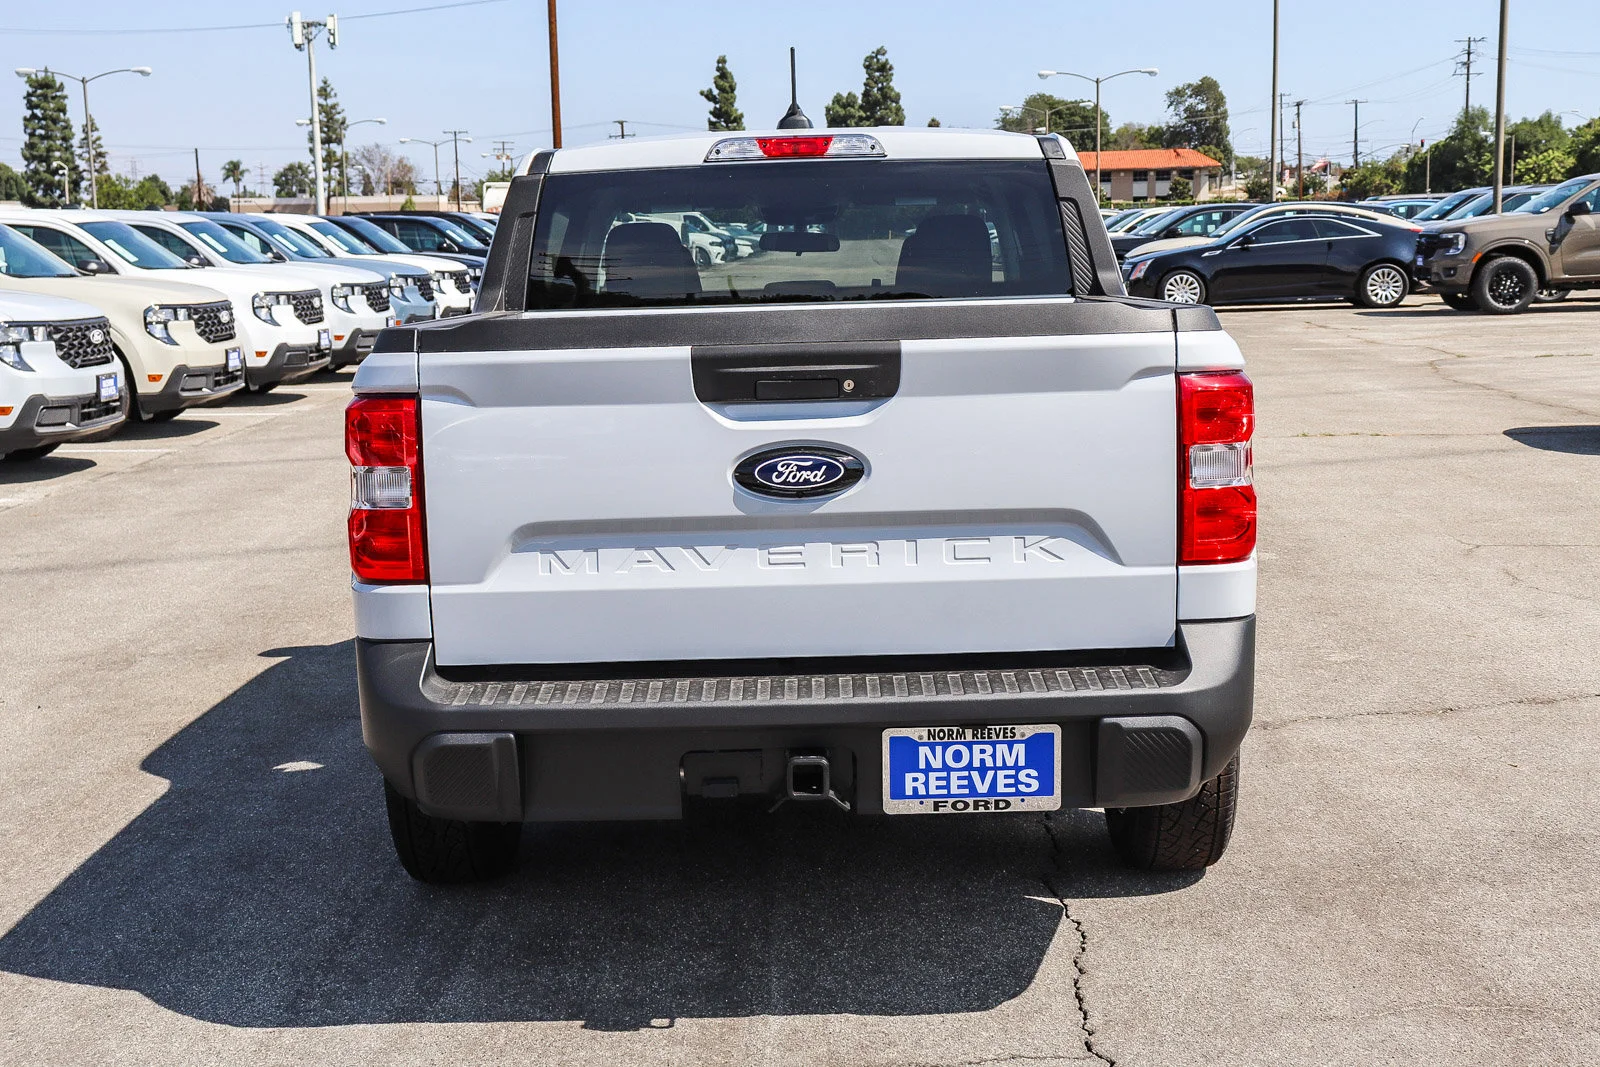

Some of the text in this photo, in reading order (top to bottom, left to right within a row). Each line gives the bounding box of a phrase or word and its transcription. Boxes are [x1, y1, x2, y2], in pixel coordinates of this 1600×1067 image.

[772, 460, 827, 483] Ford
[538, 535, 1066, 576] MAVERICK
[927, 727, 1016, 741] NORM REEVES
[918, 743, 1026, 769] NORM
[904, 769, 1040, 796] REEVES
[932, 799, 1012, 812] FORD
